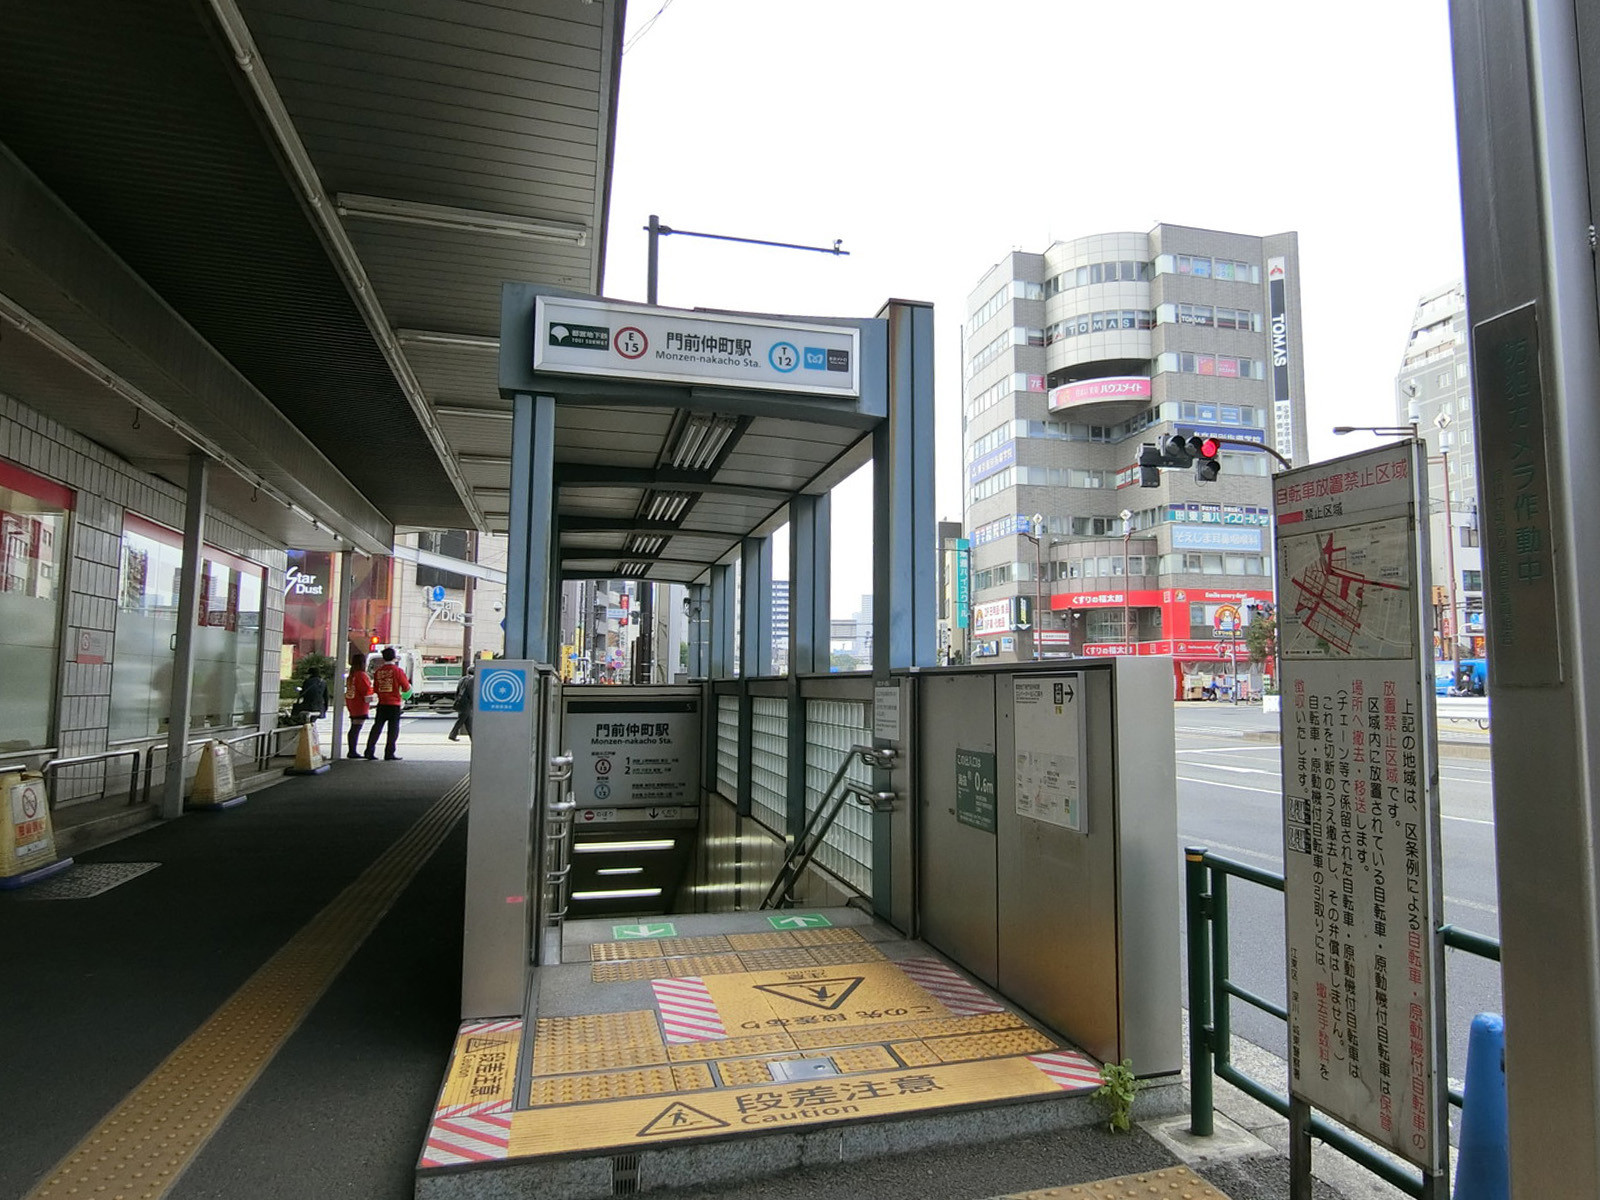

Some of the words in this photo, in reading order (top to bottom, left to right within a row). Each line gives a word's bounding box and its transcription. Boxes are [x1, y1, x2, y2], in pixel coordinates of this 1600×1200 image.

[1068, 318, 1132, 336] TOMAS
[628, 333, 635, 341] E
[666, 332, 752, 356] 門前仲町駅
[1272, 313, 1287, 367] TOMAS
[624, 342, 639, 353] 15
[781, 347, 788, 355] T
[655, 350, 740, 366] Monzen-nakacho
[743, 358, 761, 368] Sta.
[777, 356, 792, 367] 12
[1100, 383, 1142, 394] ハウスメイト
[1276, 458, 1408, 506] 自転車放置禁止区域
[1304, 502, 1343, 522] 禁止区域
[284, 566, 317, 598] Star
[296, 583, 323, 595] Dust
[1072, 594, 1124, 604] くすりの福太郎
[441, 610, 465, 622] Dus
[596, 723, 670, 737] 門前仲町駅
[591, 737, 657, 745] Monzen-nakacho
[625, 757, 631, 765] 1
[624, 766, 631, 775] 2
[740, 1012, 848, 1030] 段差あり
[470, 1052, 506, 1097] 段差注意
[736, 1073, 944, 1115] 段差注意
[740, 1103, 859, 1125] Caution
